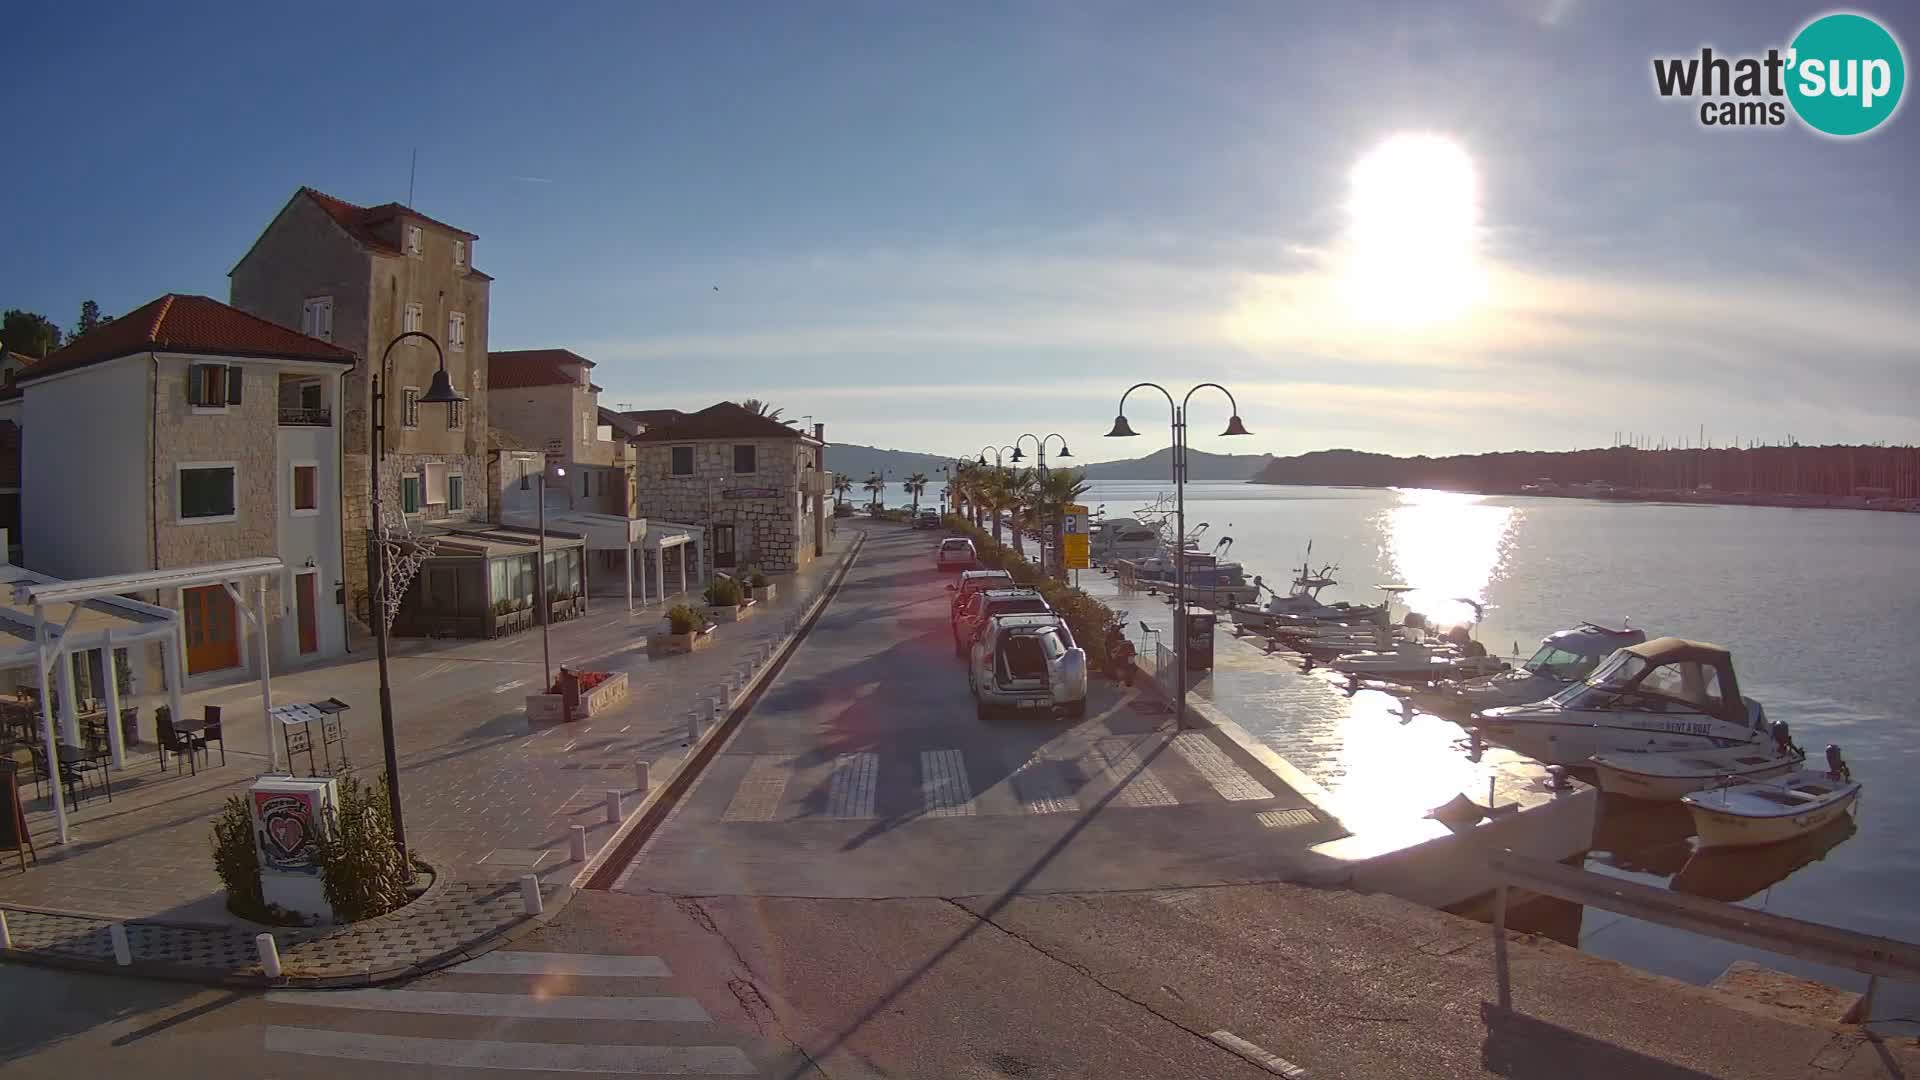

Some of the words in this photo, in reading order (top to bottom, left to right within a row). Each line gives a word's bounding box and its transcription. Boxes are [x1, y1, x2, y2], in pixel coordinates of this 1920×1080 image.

[1065, 515, 1076, 532] P
[1666, 721, 1686, 733] RENT
[1695, 723, 1712, 735] BOAT
